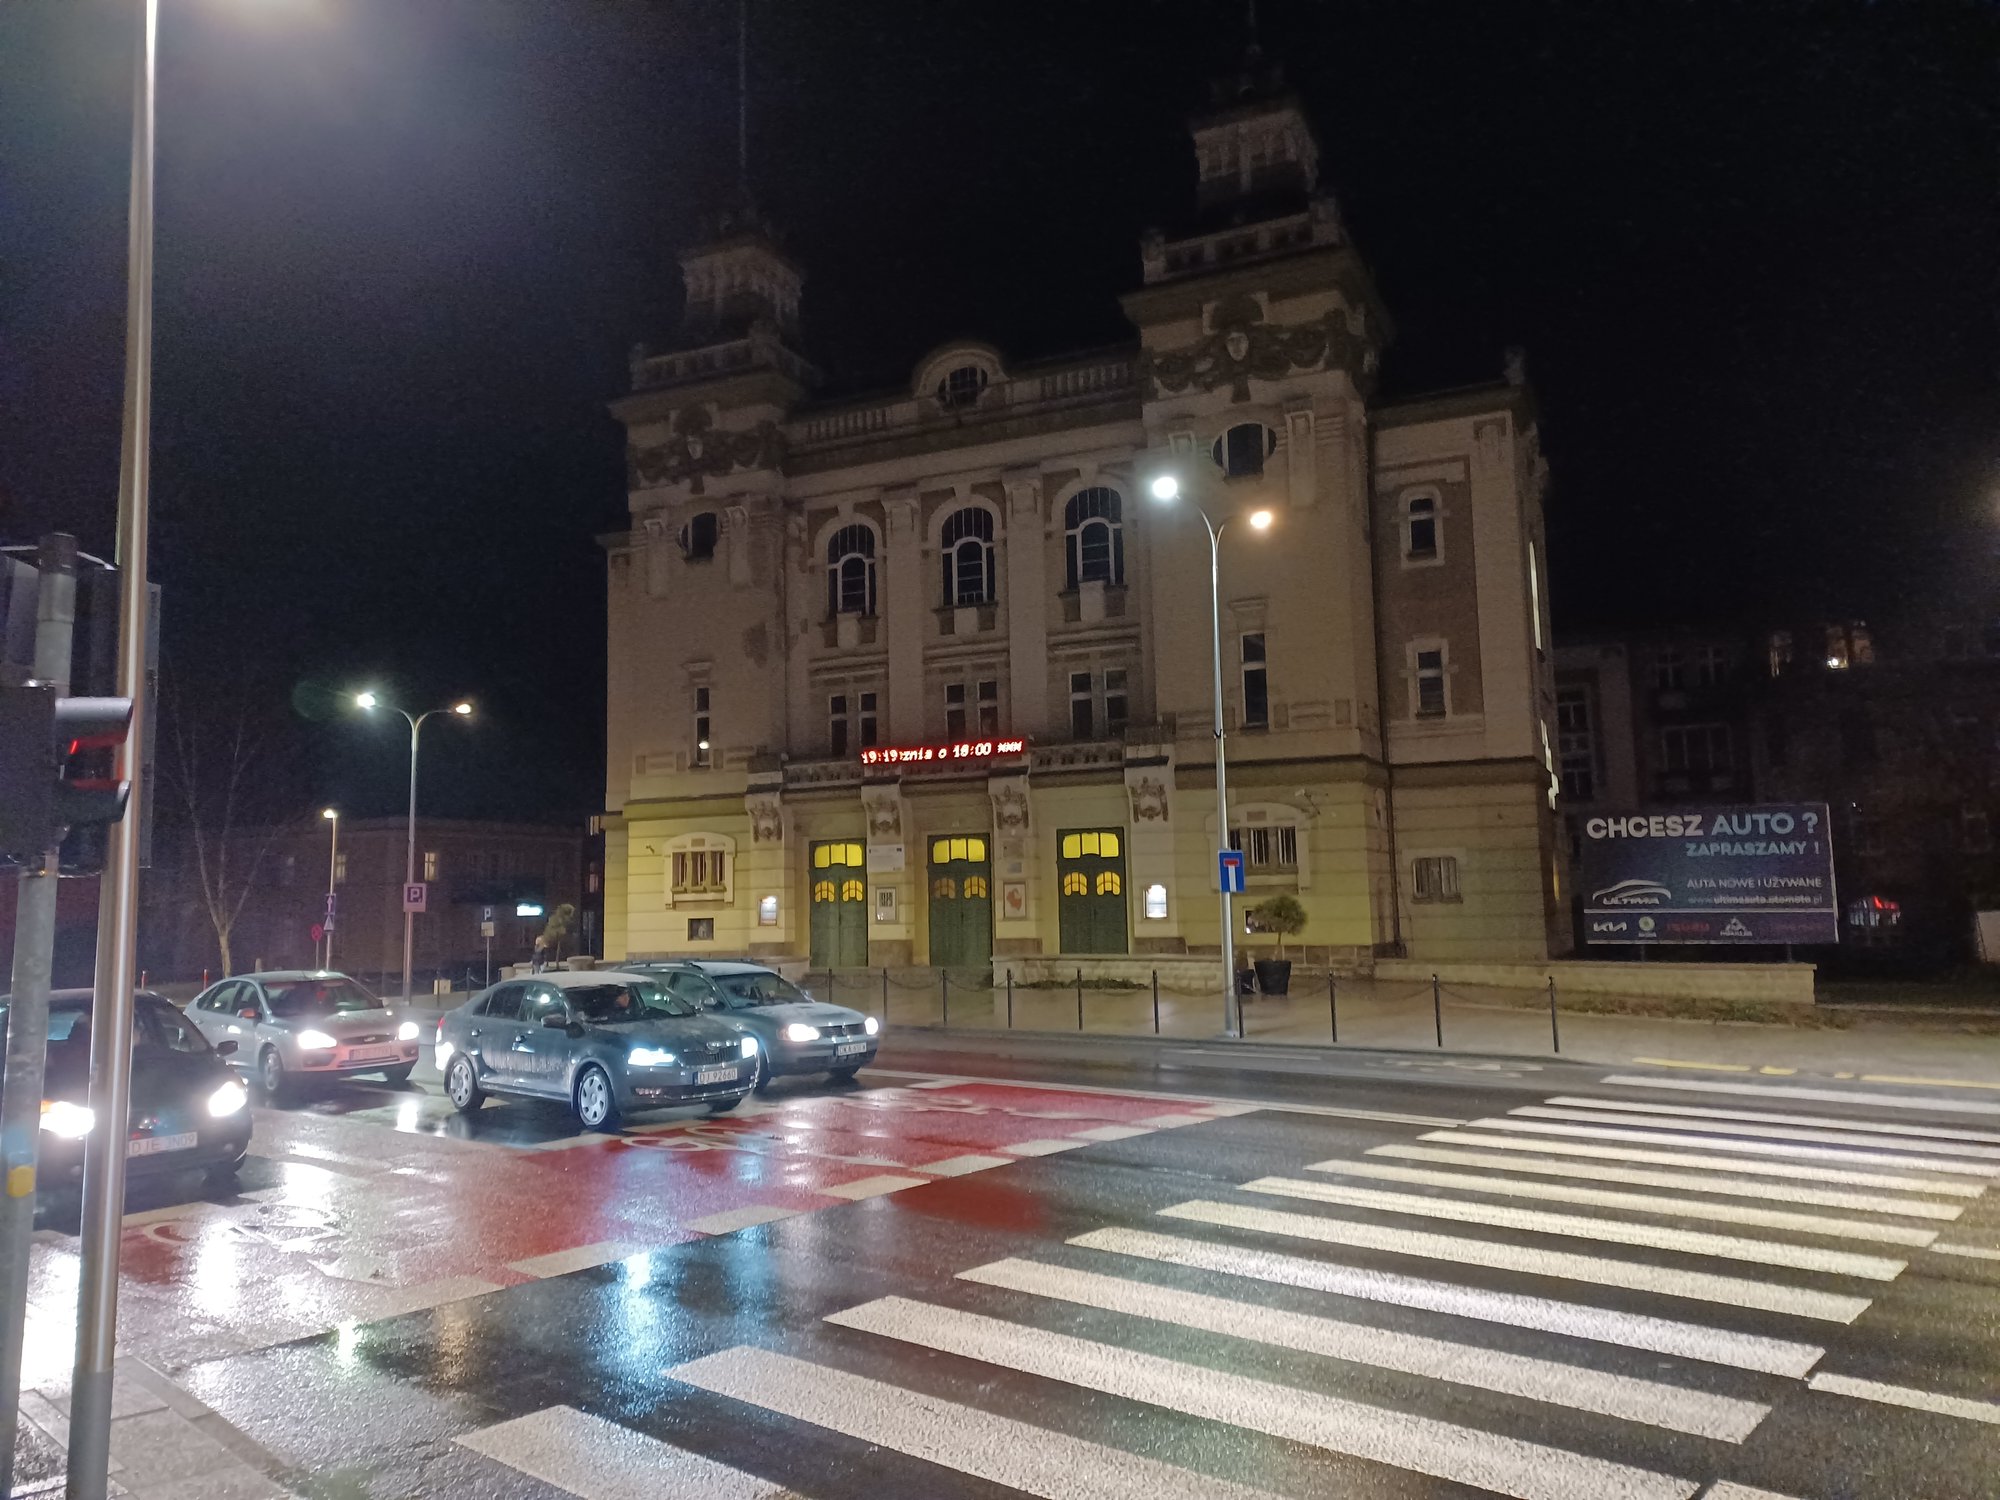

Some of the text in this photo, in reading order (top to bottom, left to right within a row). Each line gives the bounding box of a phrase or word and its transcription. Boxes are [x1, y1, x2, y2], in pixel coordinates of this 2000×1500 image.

[1586, 811, 1819, 839] CHCESZ AUTO ?
[1685, 841, 1820, 857] ZAPRASZAMY !
[1687, 878, 1716, 889] AUTA
[1719, 877, 1755, 889] NOWE
[1763, 876, 1824, 888] UŻYWANE
[484, 907, 491, 921] P
